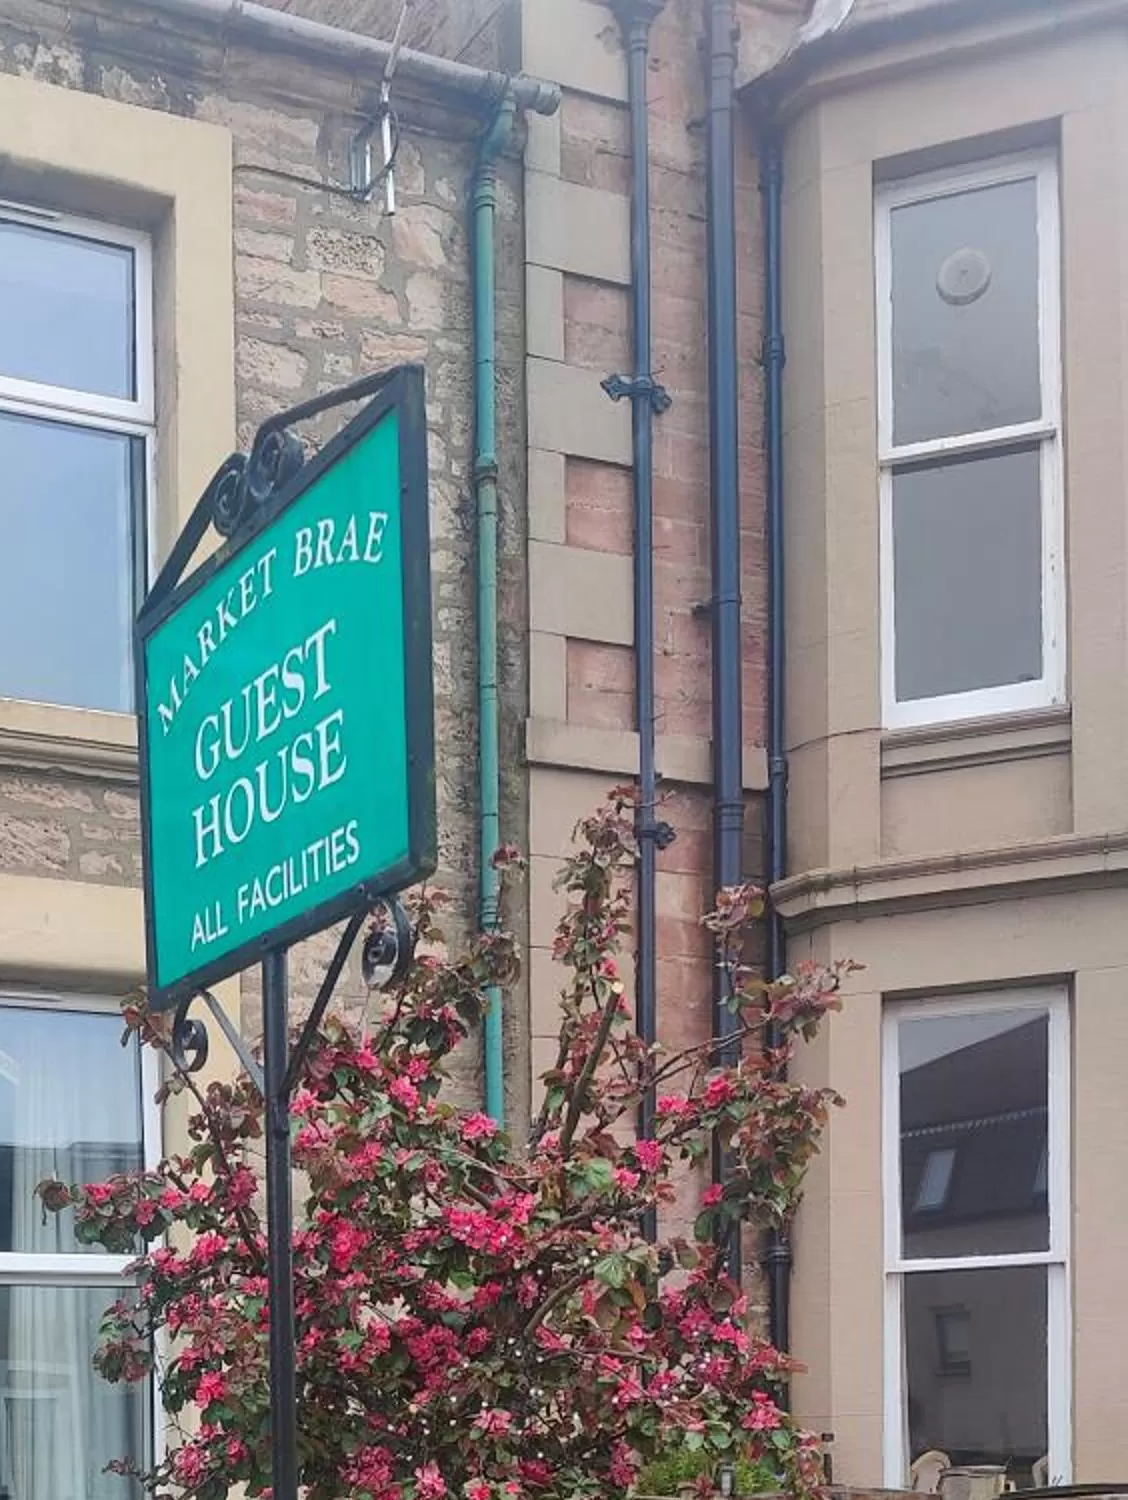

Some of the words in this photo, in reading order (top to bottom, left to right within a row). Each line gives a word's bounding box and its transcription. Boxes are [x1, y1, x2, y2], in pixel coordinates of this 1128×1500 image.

[156, 547, 278, 735] MARKET
[293, 511, 388, 577] BRAE
[194, 618, 338, 781] GUEST
[192, 709, 348, 868] HOUSE
[189, 903, 228, 951] ALL
[237, 820, 361, 923] FACILITIES
